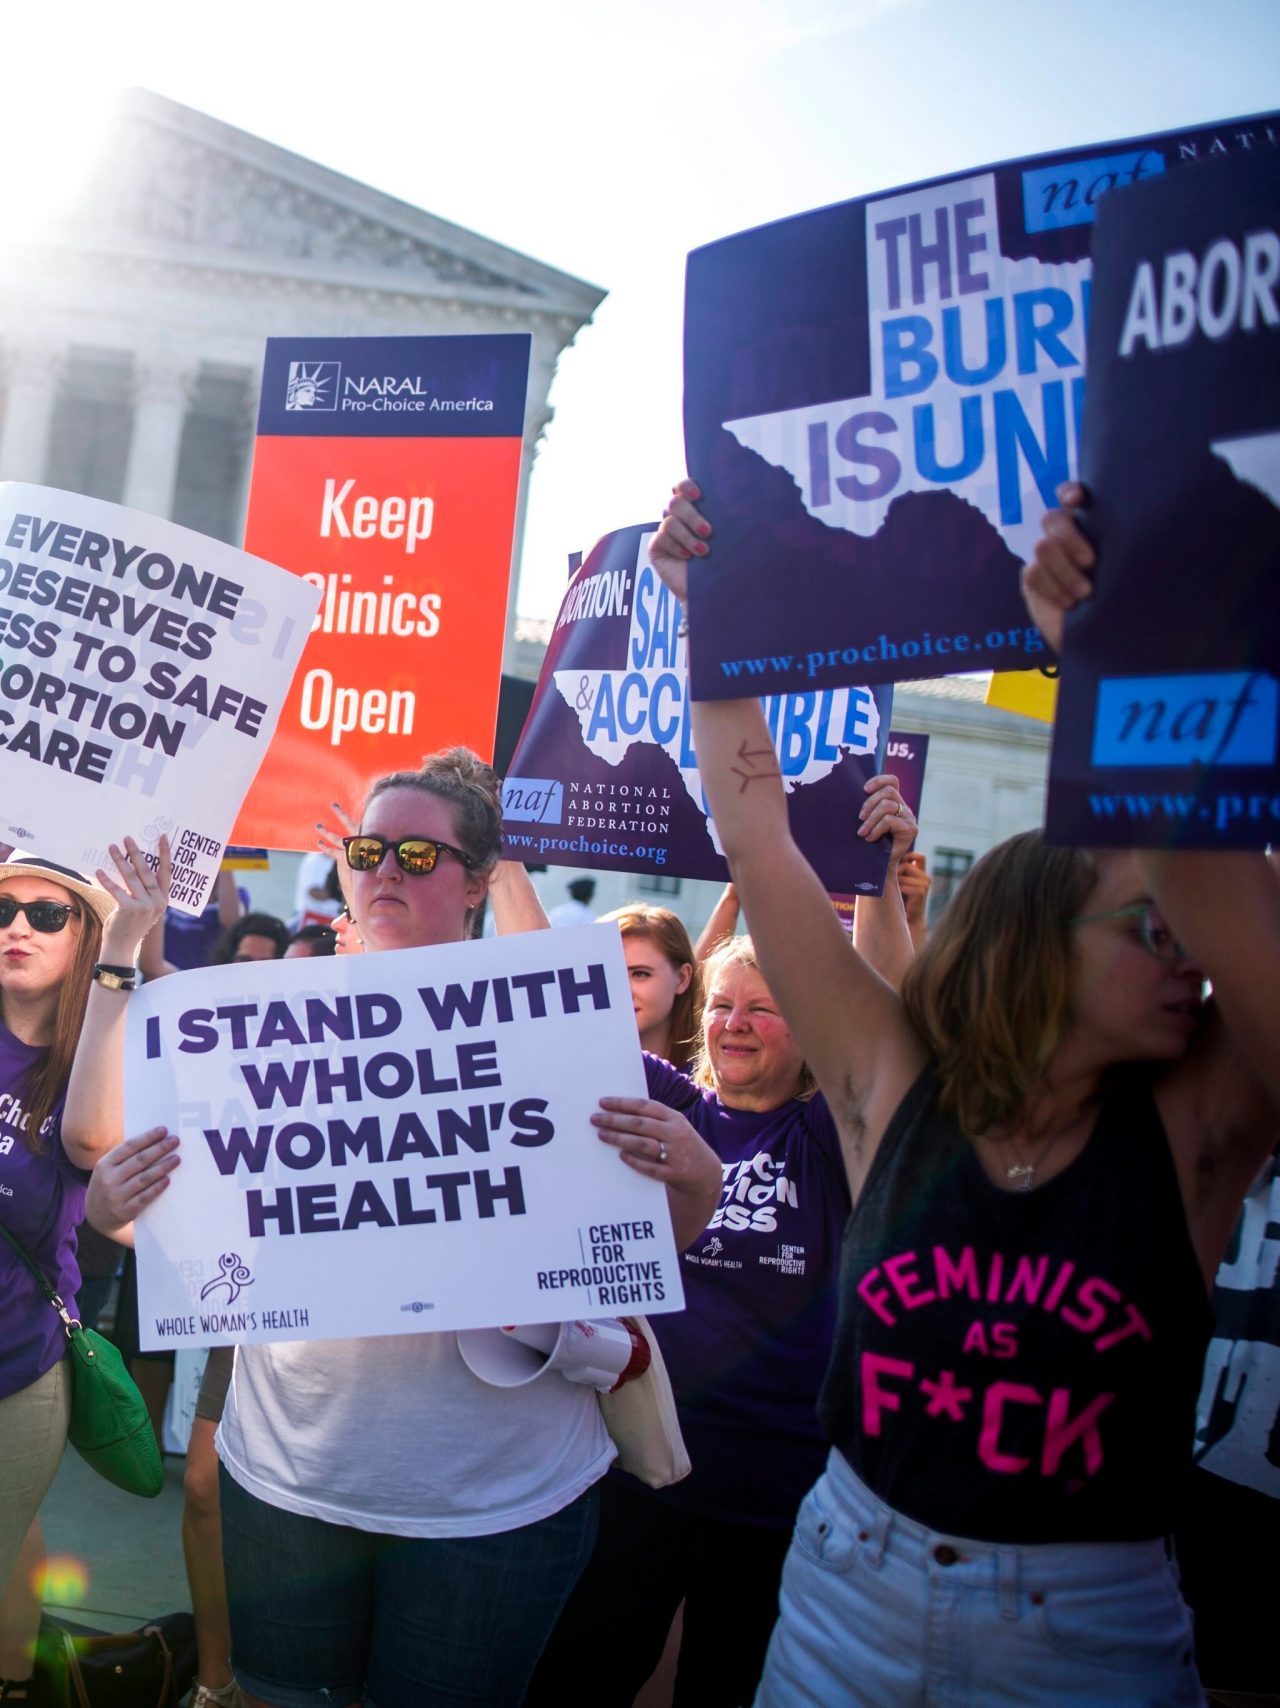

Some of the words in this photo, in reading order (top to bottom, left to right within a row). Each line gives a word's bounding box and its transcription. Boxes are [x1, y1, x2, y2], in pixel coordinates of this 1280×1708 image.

[875, 197, 991, 311] THE
[1119, 231, 1280, 357] ABOR
[881, 280, 1091, 400] BUR
[342, 398, 425, 413] Pro-Choice
[429, 398, 494, 412] America
[344, 376, 427, 396] NARAL
[805, 410, 902, 509] IS
[912, 375, 1087, 527] UN
[320, 478, 434, 554] Keep
[4, 513, 244, 621] EVERYONE
[632, 566, 688, 671] SAF
[719, 625, 1045, 680] www.prochoice.org
[70, 631, 136, 683] TO
[143, 661, 268, 738] SAFE
[299, 668, 416, 746] Open
[1117, 669, 1268, 768] naf
[506, 780, 560, 823] naf
[568, 800, 670, 817] ABORTION
[570, 782, 671, 799] NATIONAL
[180, 829, 221, 858] CENTER
[567, 816, 669, 834] FEDERATION
[173, 845, 198, 867] FOR
[146, 1015, 161, 1060] I
[177, 992, 403, 1054] STAND
[417, 963, 611, 1031] WITH
[240, 1039, 502, 1110] WHOLE
[203, 1097, 555, 1176] WOMAN'S
[246, 1165, 526, 1238] HEALTH
[589, 1221, 655, 1245] CENTER
[781, 1244, 805, 1254] CENTER
[592, 1244, 625, 1264] FOR
[685, 1253, 700, 1264] WHOLE
[700, 1257, 723, 1267] WOMAN'S
[723, 1260, 743, 1269] HEALTH
[759, 1256, 806, 1268] REPRODUCTIVE
[781, 1251, 794, 1260] FOR
[781, 1265, 805, 1275] RIGHTS
[537, 1261, 663, 1290] REPRODUCTIVE
[598, 1282, 666, 1306] RIGHTS
[856, 1245, 1153, 1354] FEMINIST
[156, 1317, 196, 1337] WHOLE
[200, 1312, 258, 1335] WOMAN'S
[262, 1308, 310, 1330] HEALTH
[963, 1320, 1019, 1360] AS
